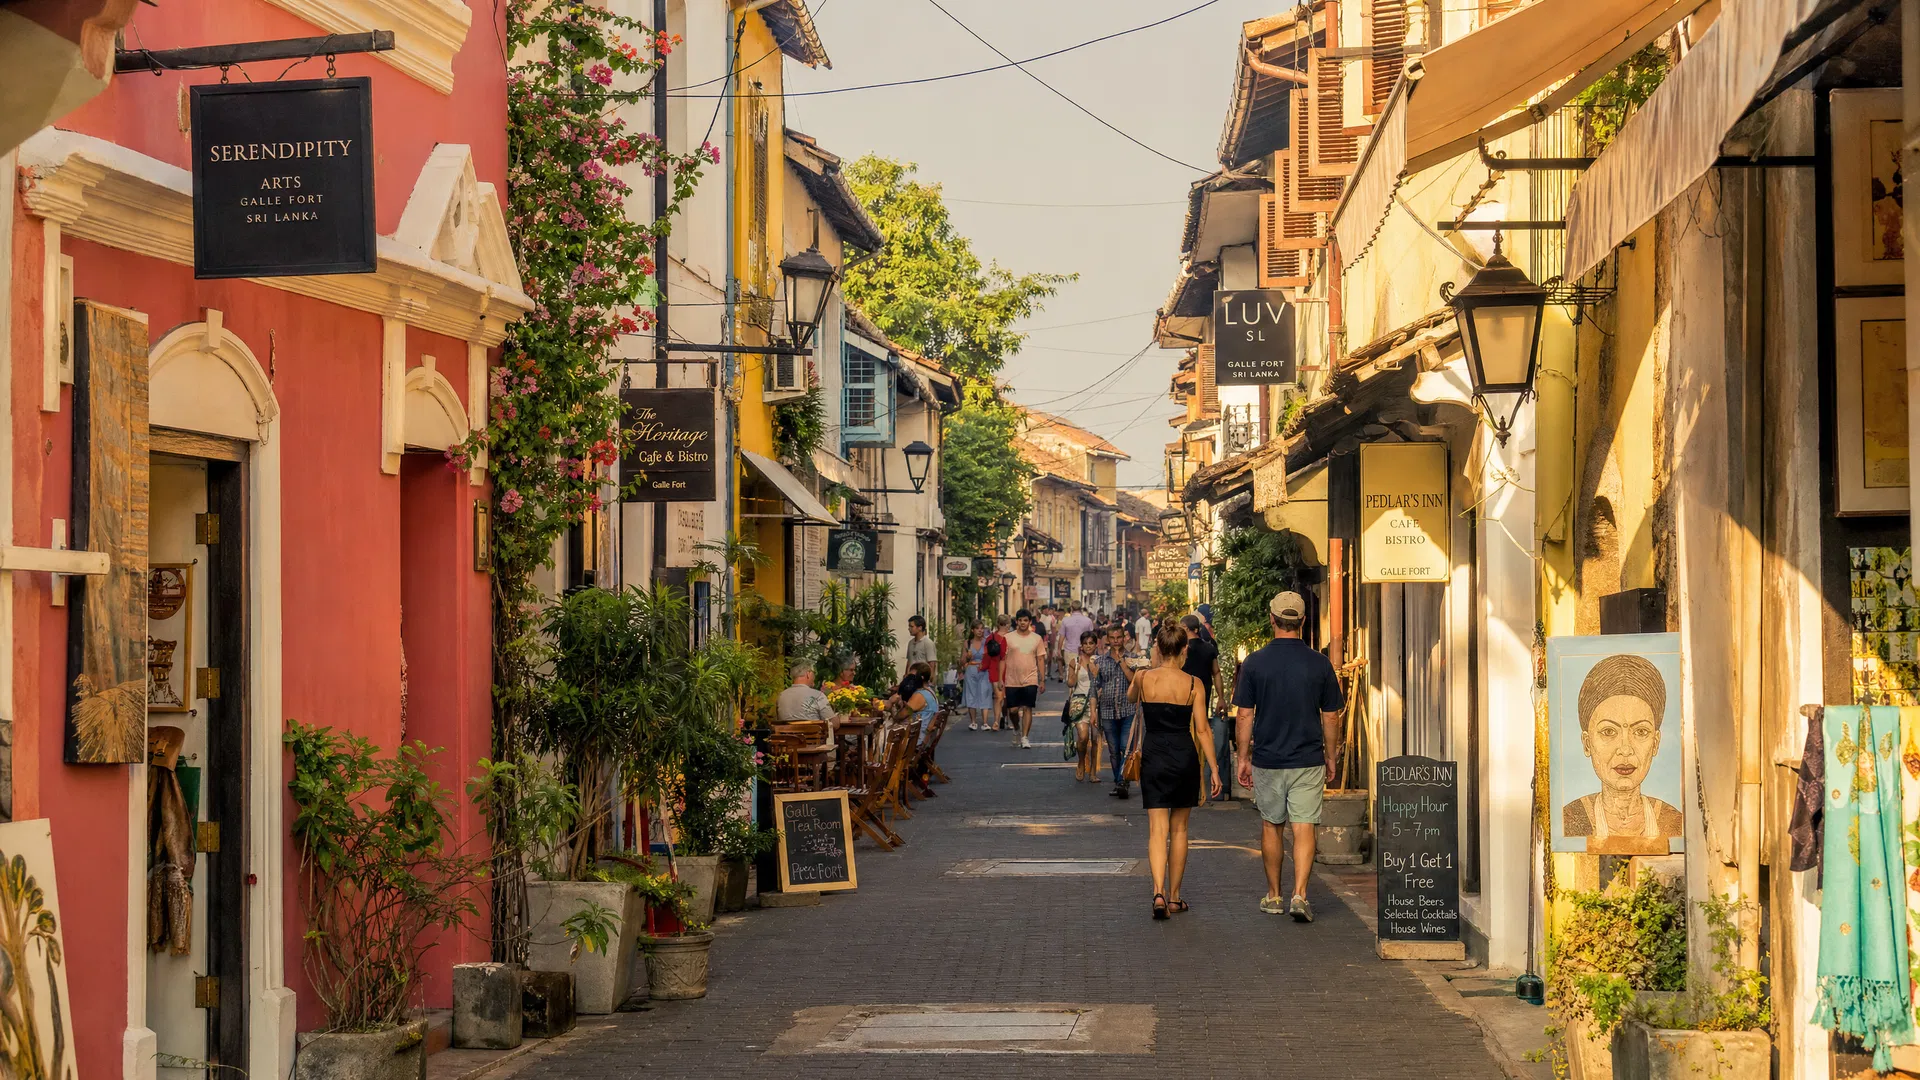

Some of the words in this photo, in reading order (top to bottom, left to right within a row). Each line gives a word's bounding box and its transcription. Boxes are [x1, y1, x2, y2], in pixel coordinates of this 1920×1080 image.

[210, 139, 352, 162] SERENDIPITY
[260, 175, 301, 190] ARTS
[240, 196, 281, 206] GALLE
[289, 194, 323, 204] FORT
[246, 214, 267, 223] SRI
[275, 211, 318, 222] LANKA
[1225, 302, 1286, 325] LUV
[1250, 370, 1280, 378] LANKA
[633, 407, 657, 420] The
[630, 421, 708, 448] Heritage
[639, 450, 662, 466] Cafe
[665, 451, 674, 462] &
[678, 451, 708, 462] Bistro
[652, 480, 670, 489] Galle
[672, 480, 686, 489] Fort
[1366, 494, 1419, 509] PEDLAR'S
[1422, 493, 1443, 508] INN
[1390, 519, 1420, 529] CAFE
[1385, 535, 1426, 545] BISTRO
[1380, 567, 1406, 576] GALLE
[1408, 567, 1431, 576] FORT
[1381, 765, 1430, 781] PEDLAR'S
[1433, 766, 1452, 781] INN
[785, 803, 818, 818] Galle
[1382, 796, 1418, 818] Happy
[1421, 795, 1449, 812] Hour
[788, 820, 812, 832] Tea
[813, 818, 841, 830] Room
[1424, 827, 1440, 841] pm
[1383, 851, 1406, 873] Buy
[1409, 852, 1416, 868] 1
[1420, 852, 1442, 868] Get
[1446, 853, 1453, 869] 1
[1405, 872, 1434, 888] Free
[1388, 894, 1414, 906] House
[1419, 894, 1445, 906] Beers
[1384, 908, 1418, 919] Selected
[1421, 909, 1457, 919] Cocktails
[1391, 922, 1416, 934] House
[1420, 923, 1446, 934] Wines
